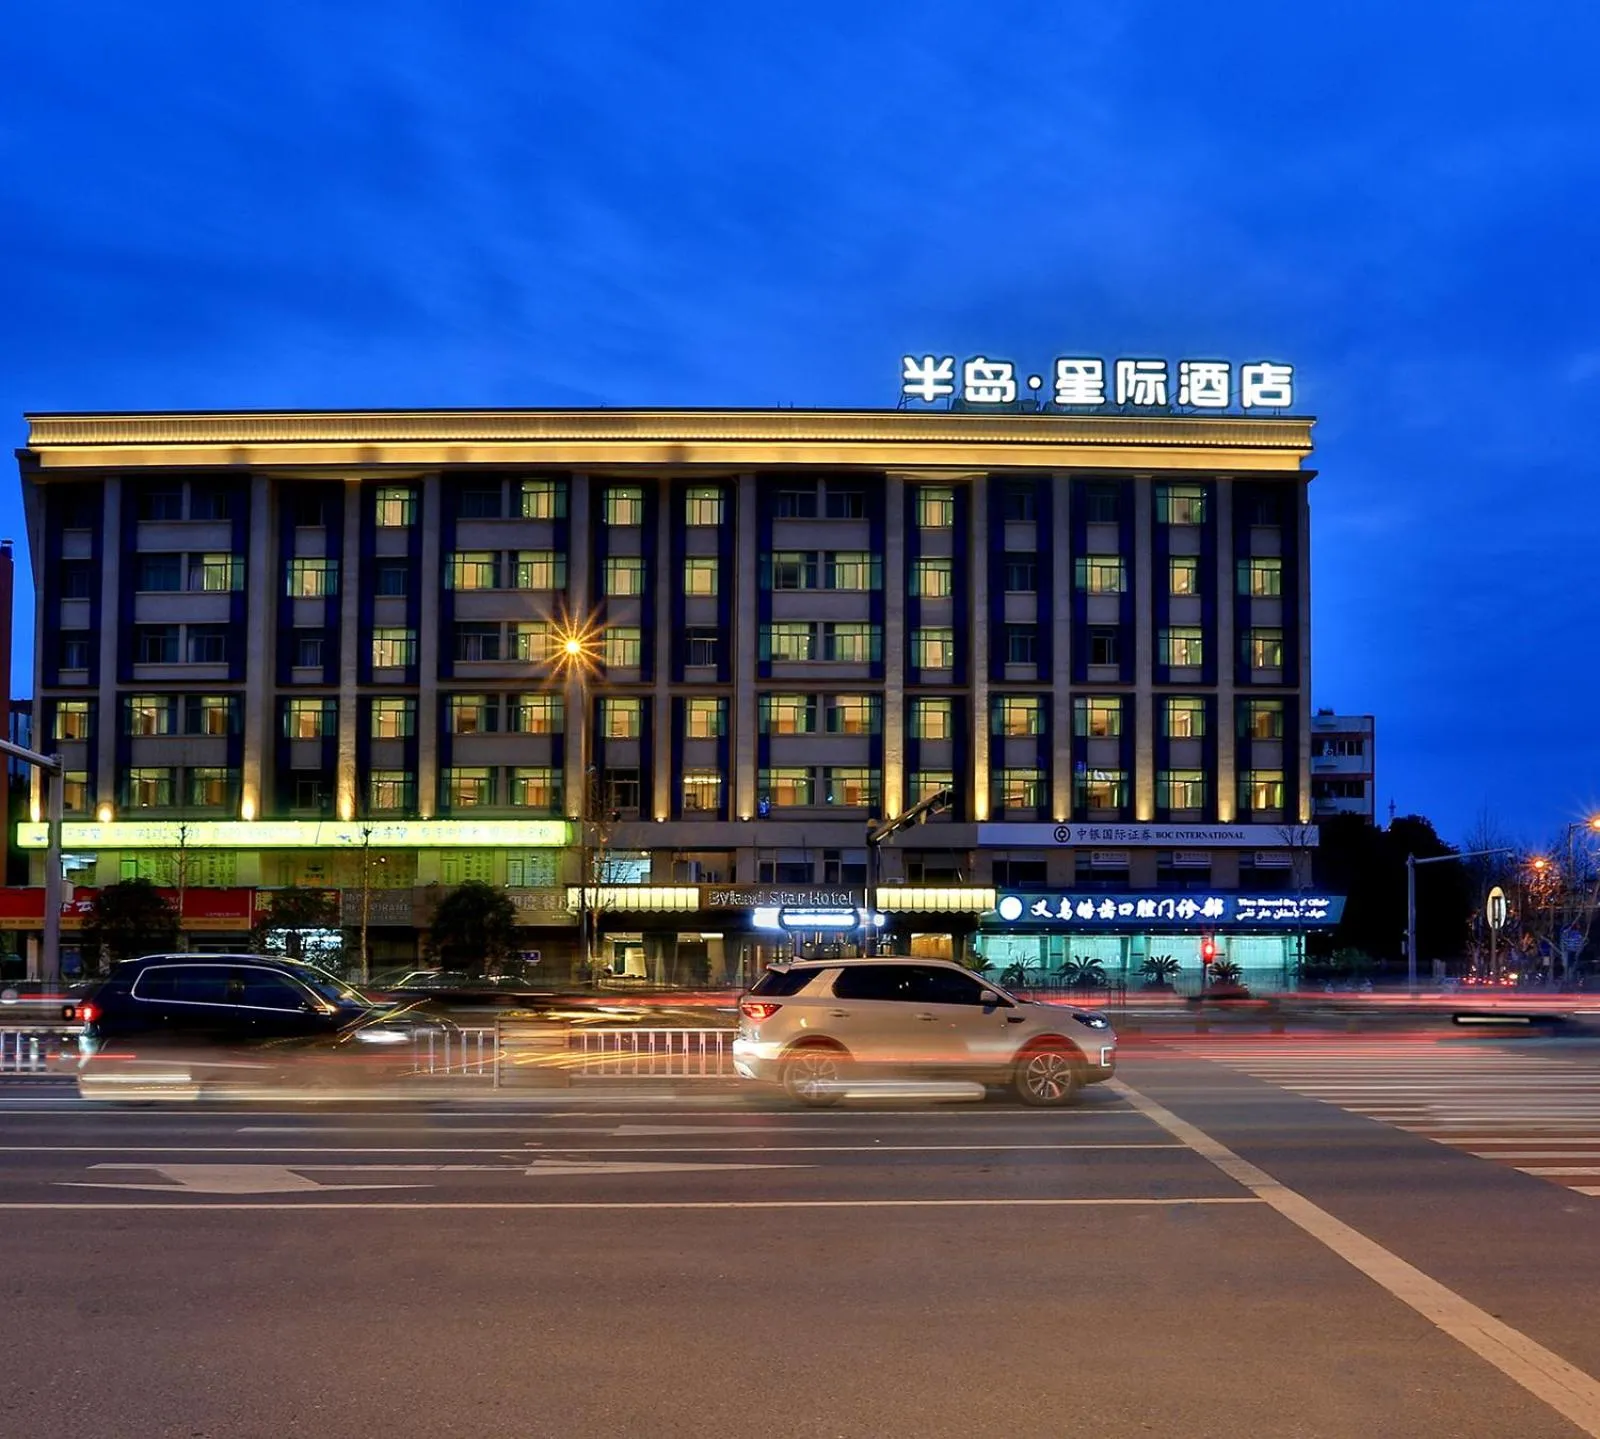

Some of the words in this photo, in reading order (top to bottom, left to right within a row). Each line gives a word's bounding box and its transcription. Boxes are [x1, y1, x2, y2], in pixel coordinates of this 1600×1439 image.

[903, 355, 1293, 407] 半岛·星际酒店
[1077, 828, 1153, 841] 中银国际证券
[1156, 831, 1174, 839] BOC
[1176, 831, 1246, 840] INTERNATIONAL
[769, 890, 805, 906] Star
[809, 890, 853, 906] Hotel
